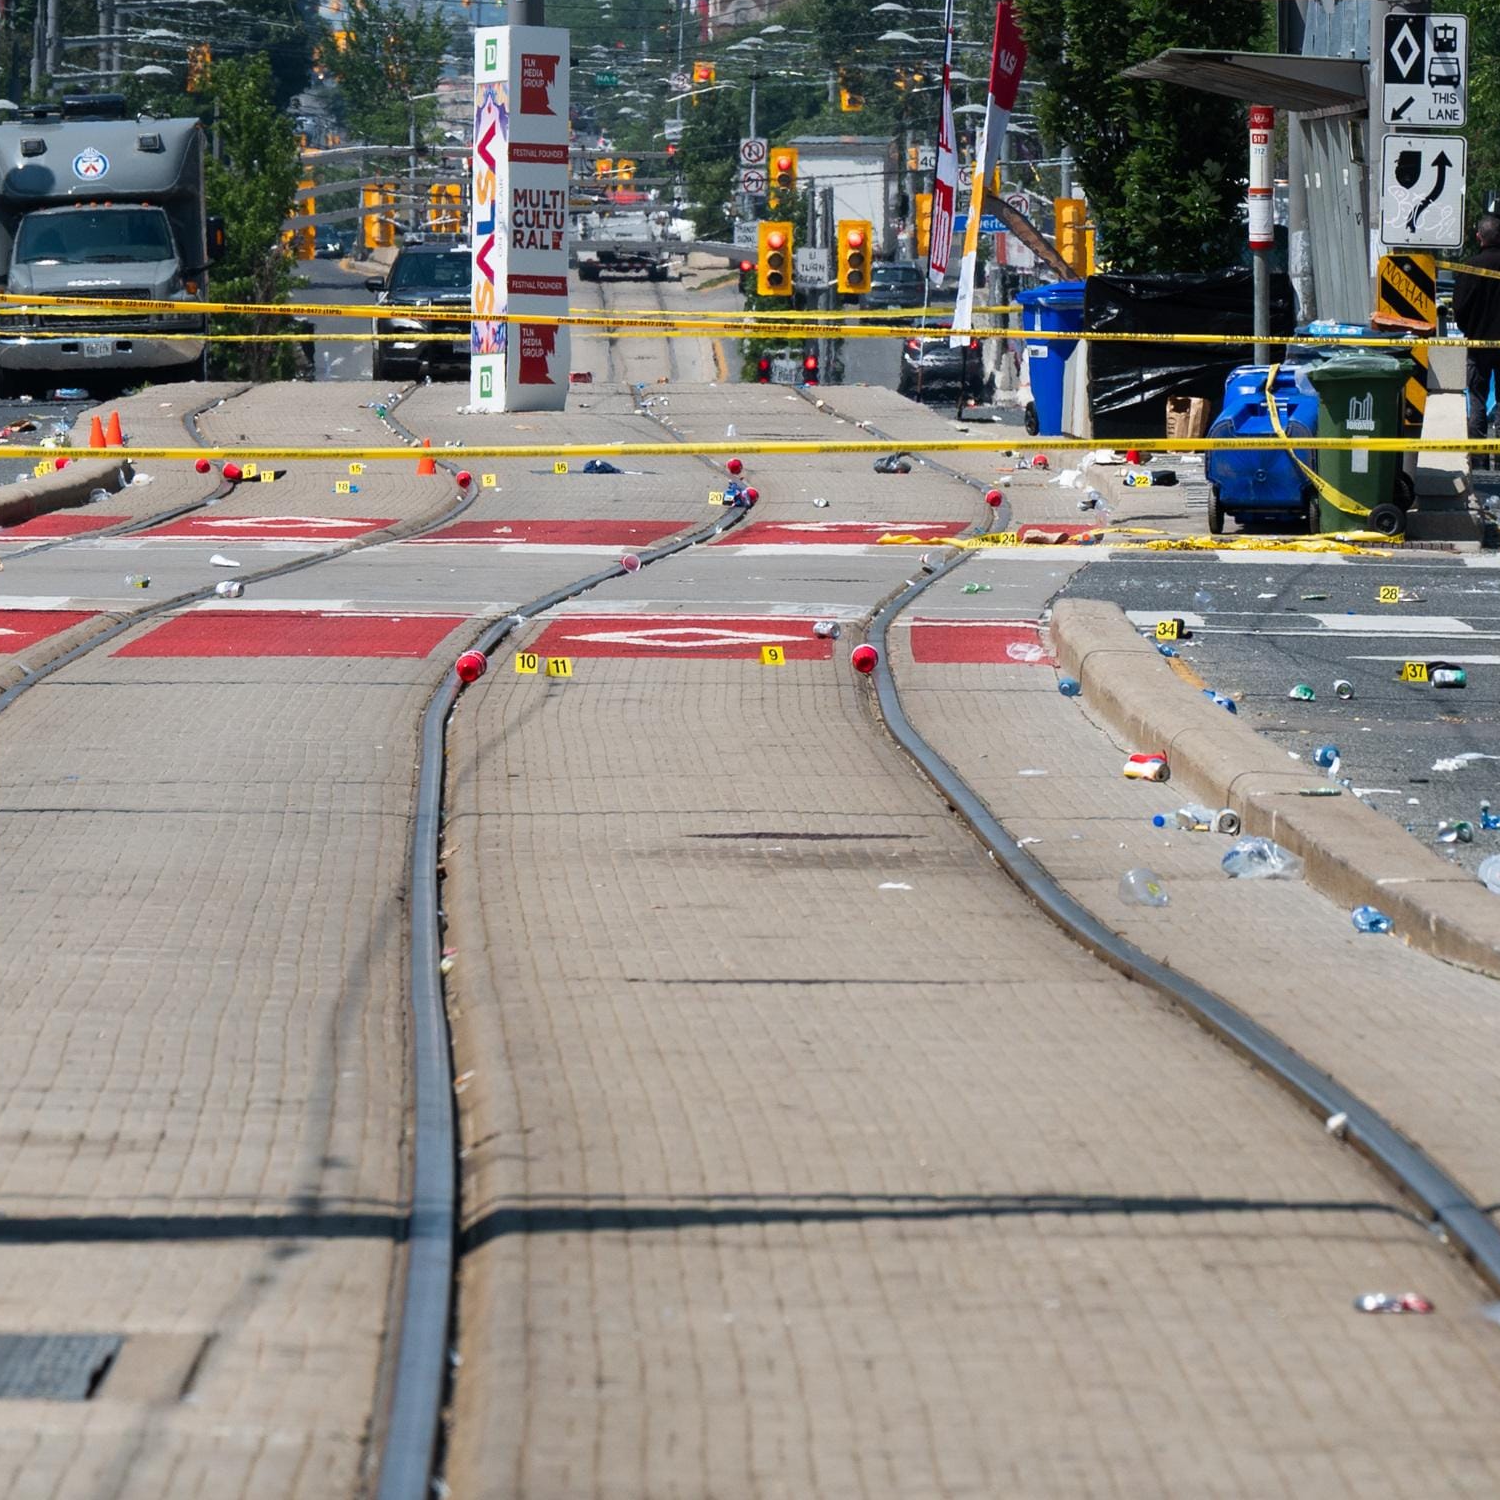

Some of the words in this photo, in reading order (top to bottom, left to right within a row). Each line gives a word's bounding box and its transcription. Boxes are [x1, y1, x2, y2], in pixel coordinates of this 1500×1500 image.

[524, 59, 535, 67] TLN
[524, 68, 543, 77] MEDIA
[523, 78, 545, 88] GROUP
[1432, 92, 1457, 104] THIS
[1428, 108, 1460, 121] LANE
[513, 149, 538, 157] FESTIVAL
[538, 150, 563, 158] FOUNDER
[513, 189, 564, 209] MULTI
[512, 210, 564, 229] CULTU
[513, 230, 549, 250] RAL
[512, 280, 536, 289] FESTIVAL
[537, 281, 562, 290] FOUNDER
[523, 328, 534, 337] TLN
[523, 338, 541, 346] MEDIA
[523, 348, 544, 357] GROUP
[486, 476, 492, 484] 5
[1137, 476, 1149, 484] 22
[338, 483, 348, 491] 18
[710, 493, 722, 502] 20
[1003, 533, 1015, 544] 24
[1382, 588, 1397, 600] 28
[1157, 622, 1175, 637] 34
[767, 649, 777, 661] 9
[518, 653, 536, 670] 10
[552, 660, 567, 674] 11
[1408, 663, 1425, 679] 37
